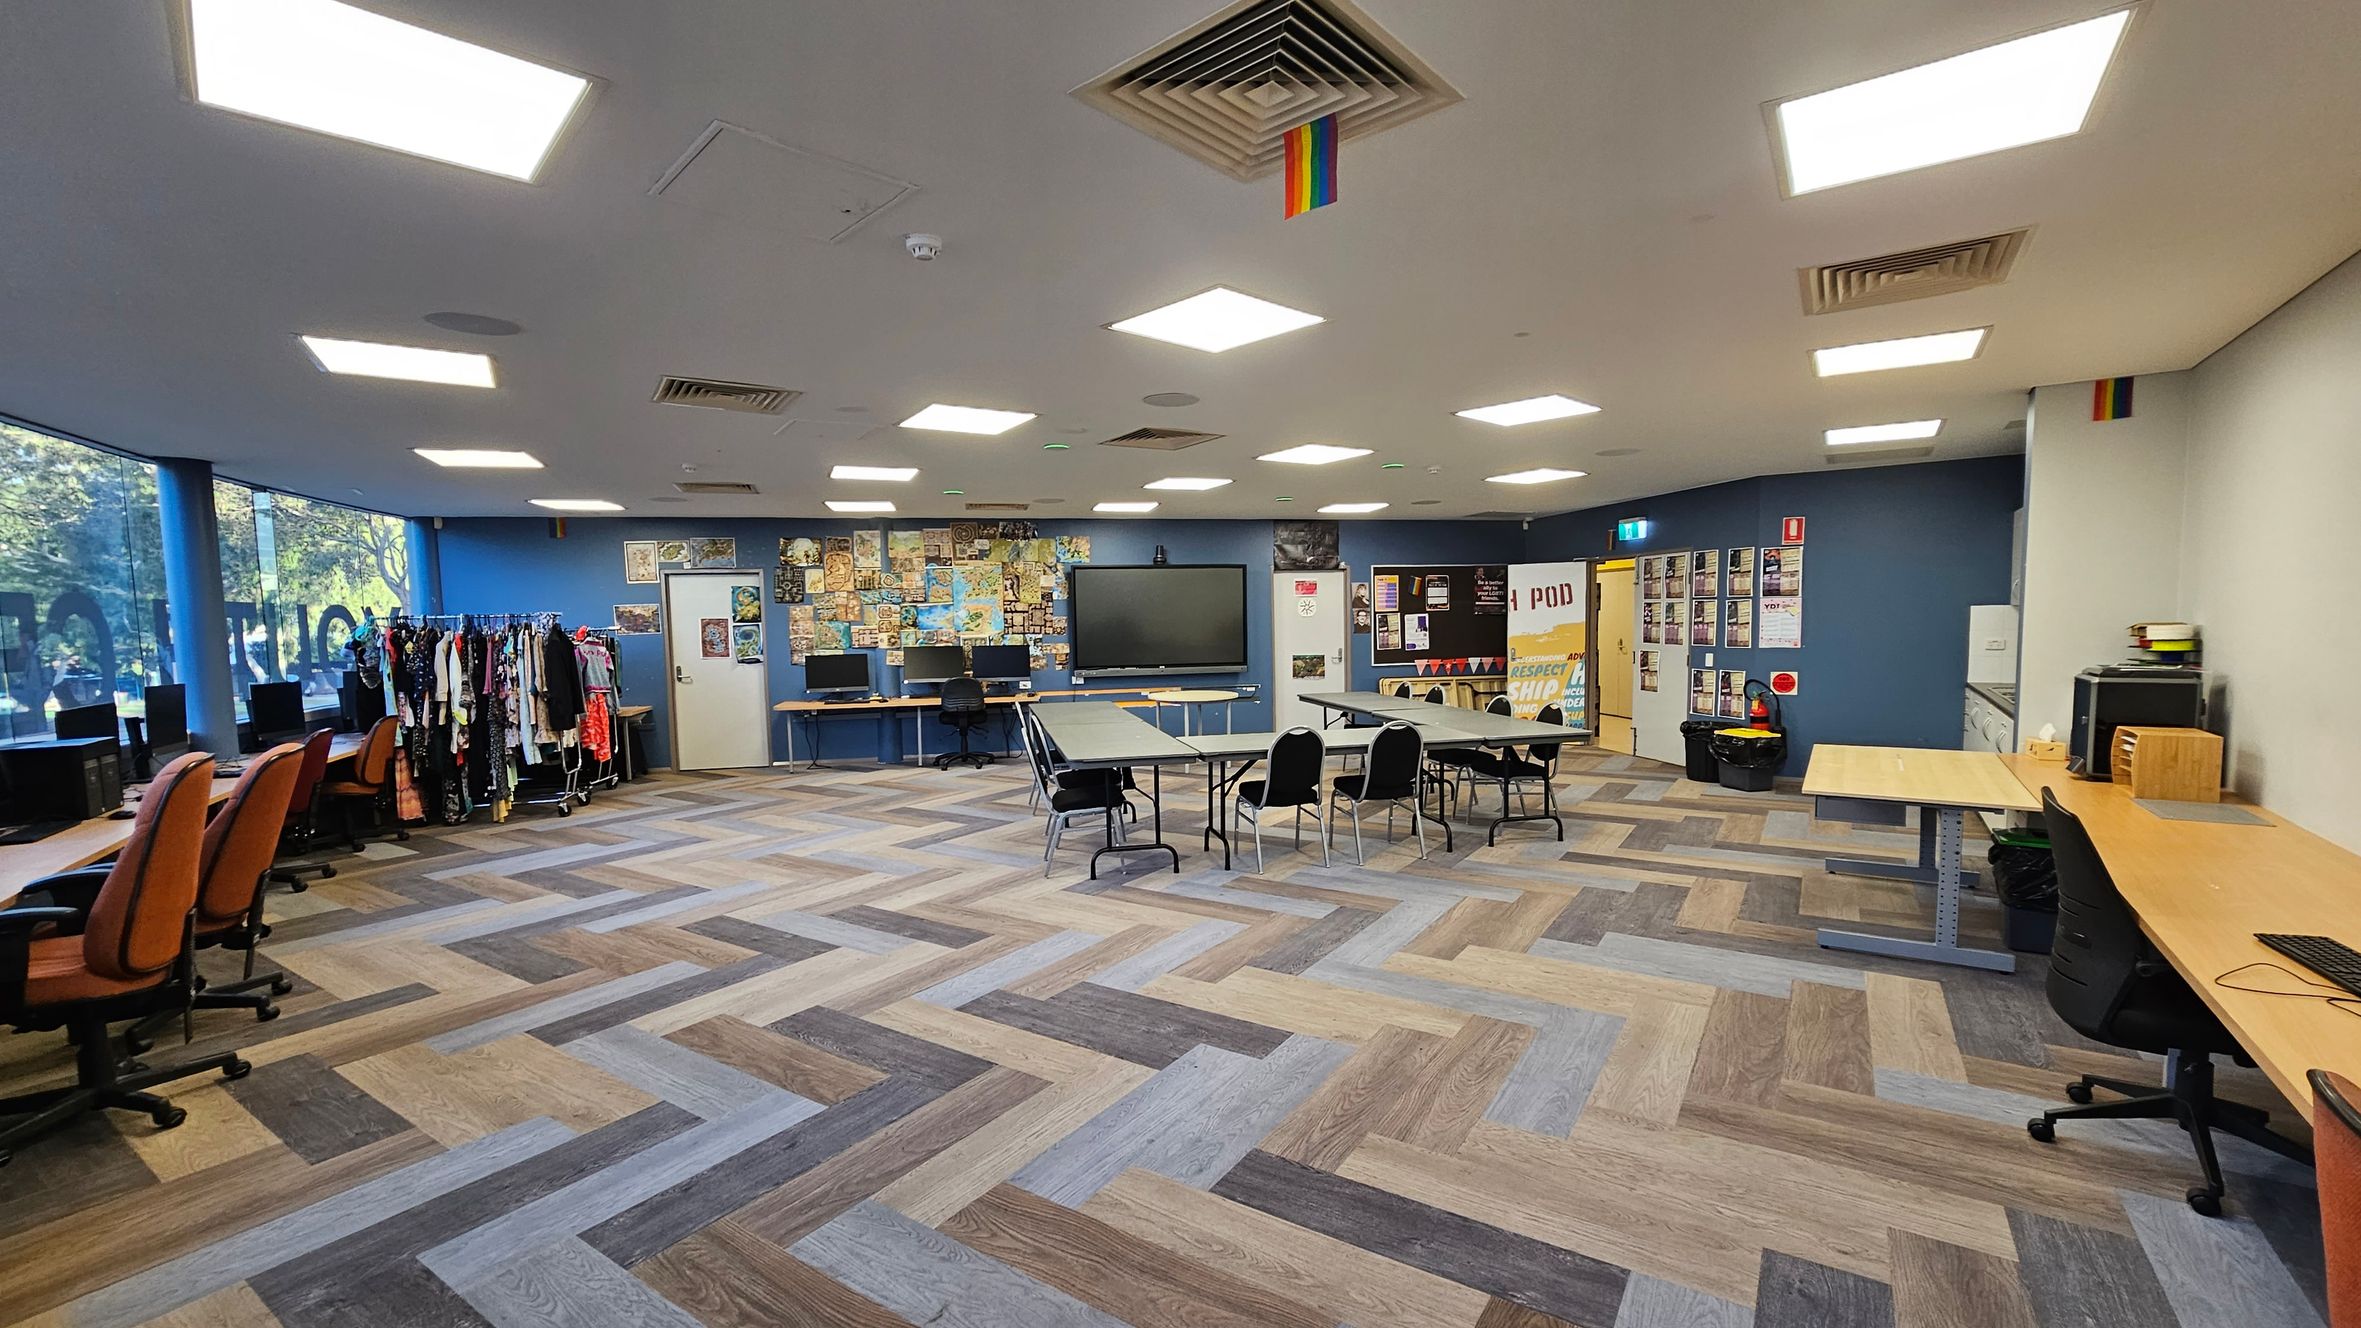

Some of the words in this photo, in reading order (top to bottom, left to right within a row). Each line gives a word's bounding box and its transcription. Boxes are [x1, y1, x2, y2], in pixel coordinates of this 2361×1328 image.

[1531, 583, 1574, 610] POD
[1510, 663, 1568, 678] RESPECT
[1508, 679, 1558, 701] SHIP
